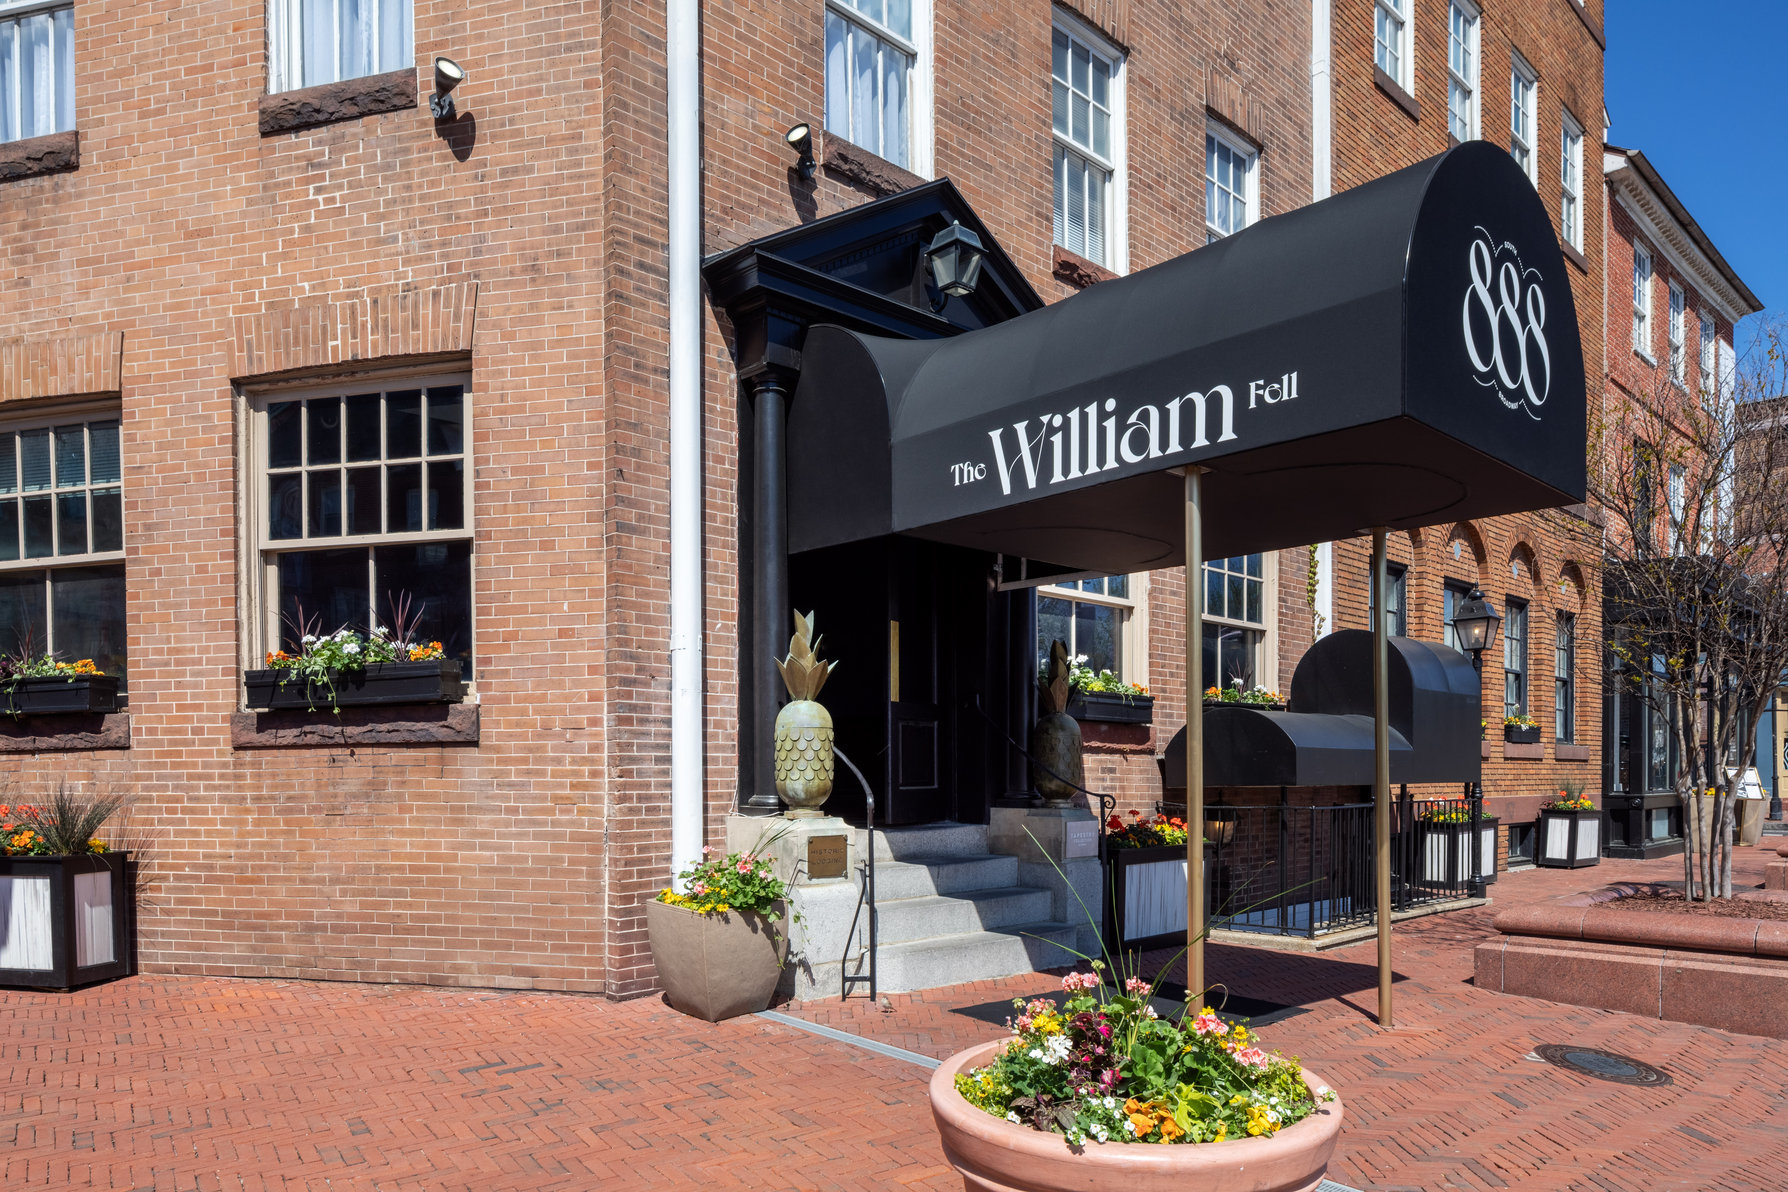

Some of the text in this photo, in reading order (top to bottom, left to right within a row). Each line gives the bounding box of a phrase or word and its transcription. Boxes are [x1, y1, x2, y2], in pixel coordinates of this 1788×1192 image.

[1463, 239, 1550, 406] 888
[951, 371, 1298, 496] The William Fell
